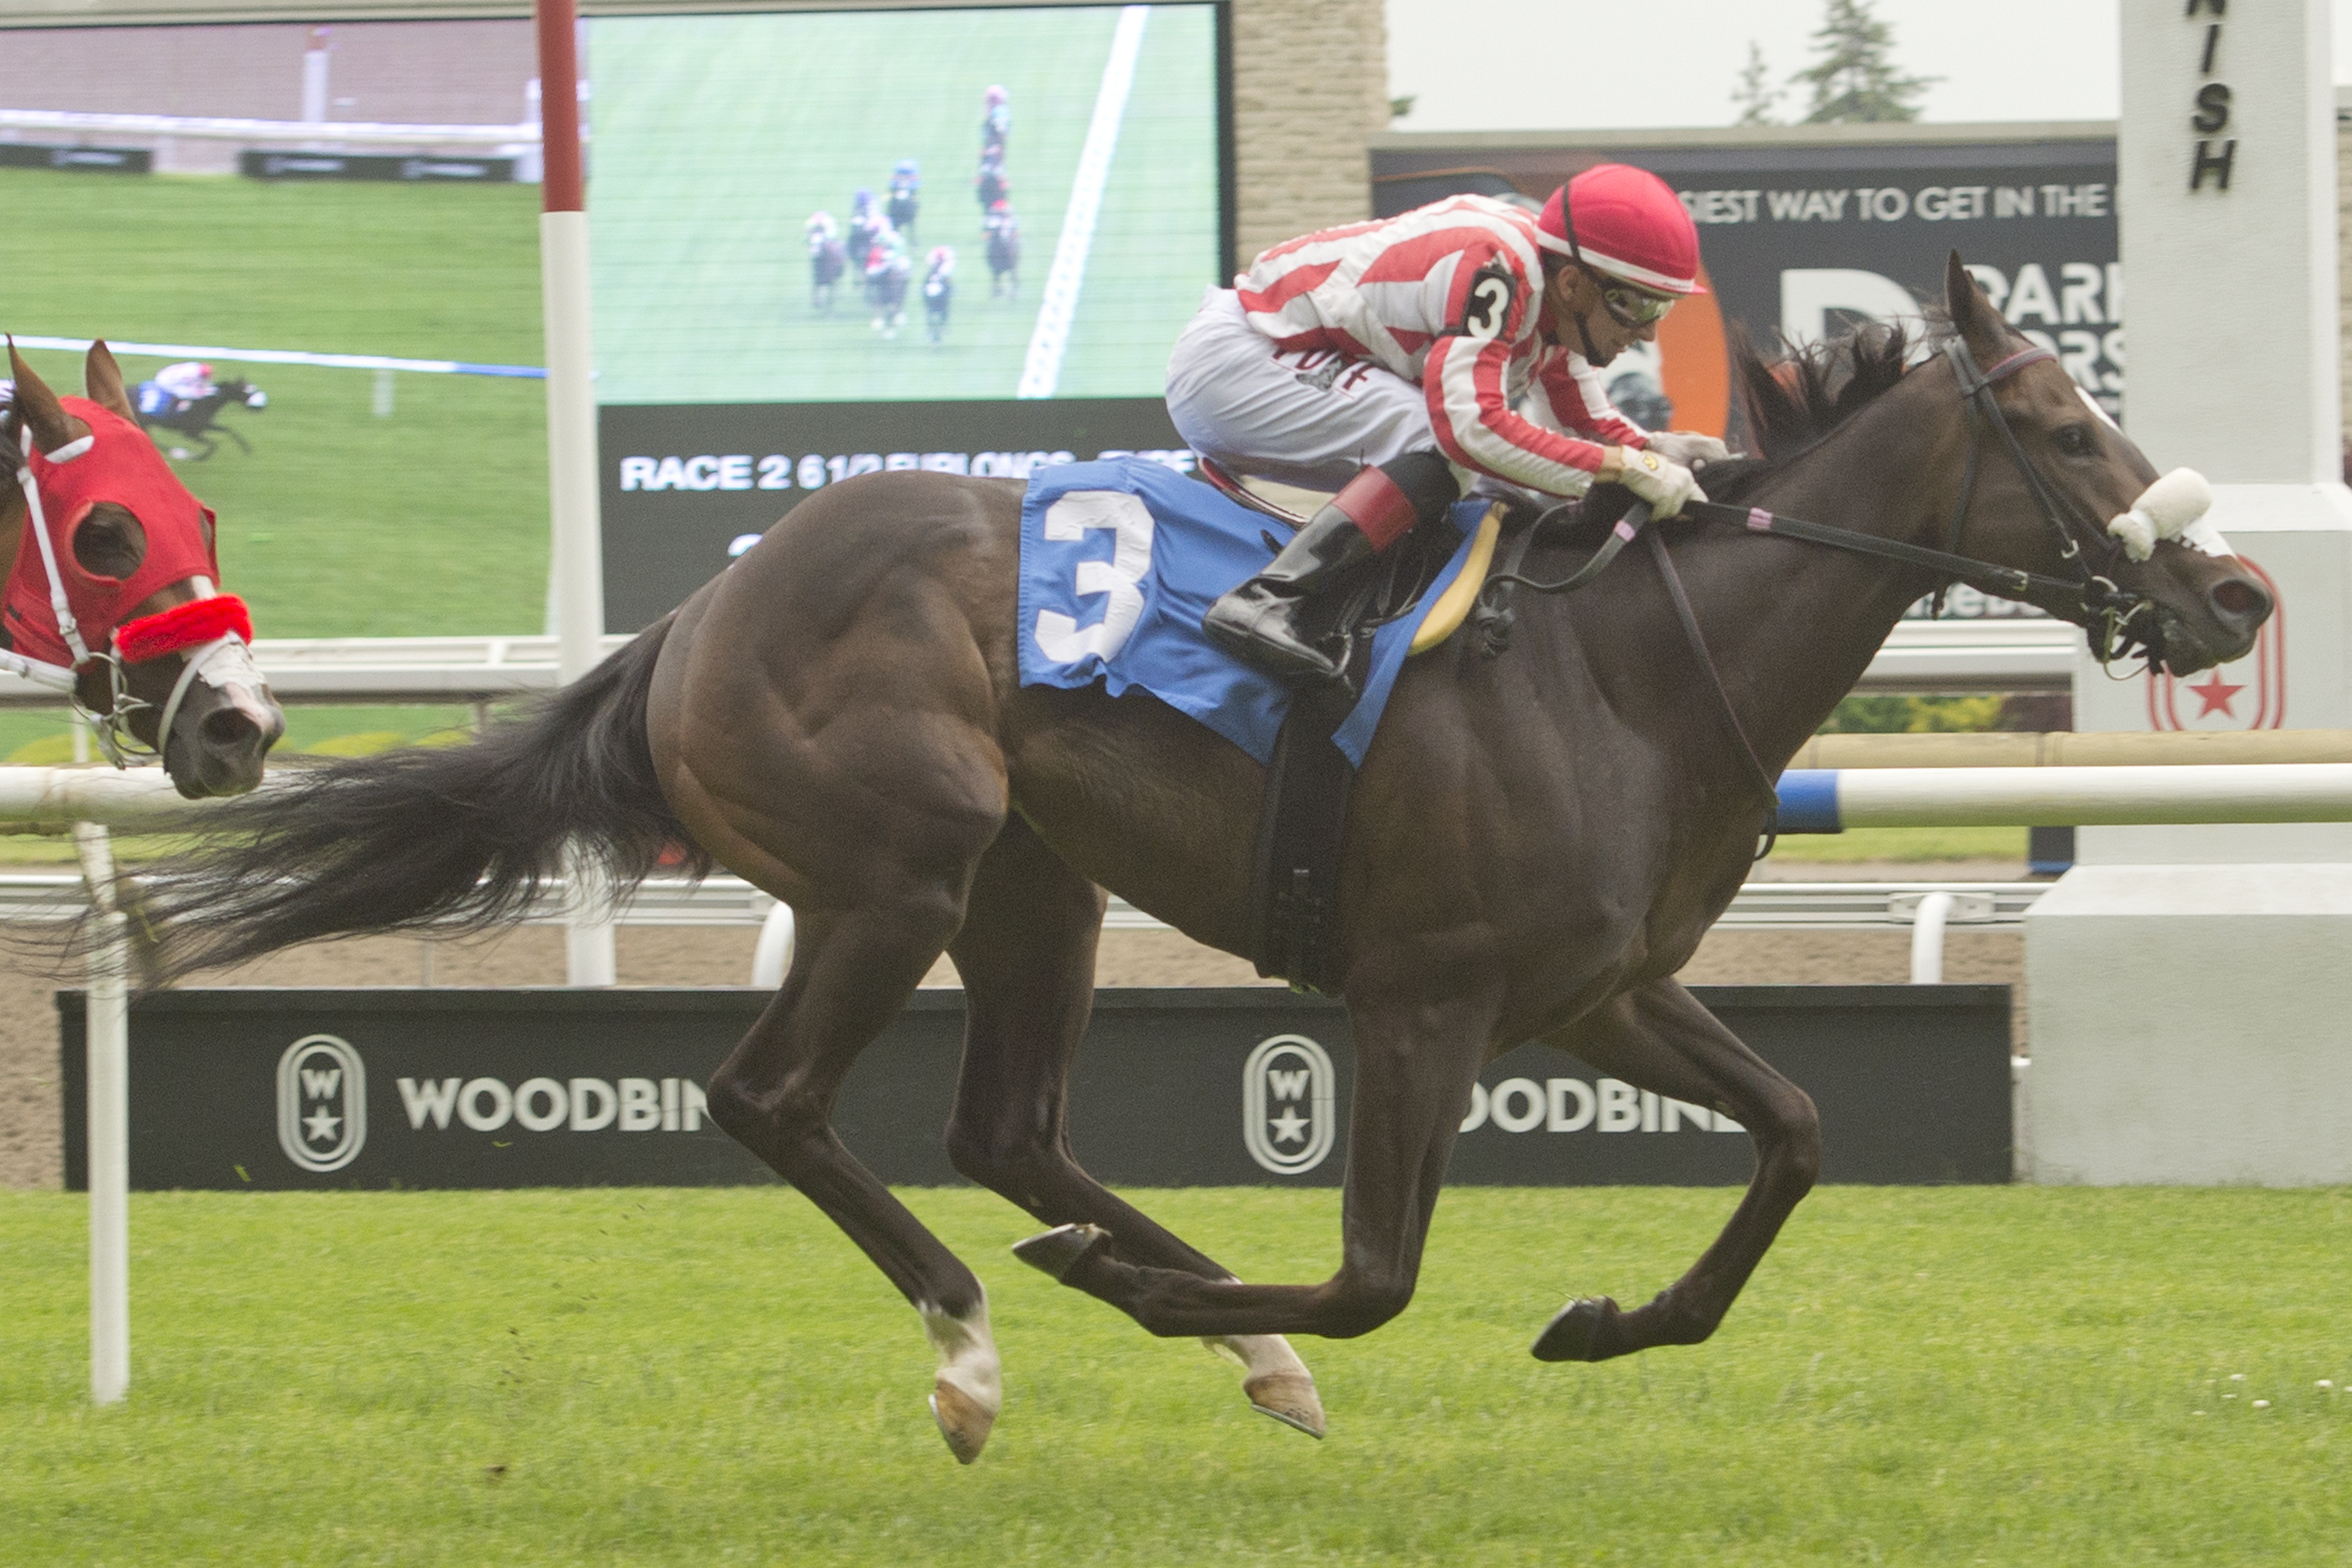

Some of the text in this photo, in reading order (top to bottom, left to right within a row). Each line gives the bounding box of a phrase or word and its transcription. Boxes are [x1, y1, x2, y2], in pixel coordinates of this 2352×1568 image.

[1767, 189, 1850, 221] WAY
[1854, 187, 1908, 221] TO
[1914, 186, 1988, 221] GET
[1994, 185, 2034, 218] IN
[2039, 184, 2108, 217] THE
[1467, 277, 1509, 338] 3
[620, 455, 754, 491] RACE
[757, 454, 792, 489] 2
[1034, 491, 1155, 662] 3
[301, 1068, 342, 1100] W
[1266, 1070, 1310, 1101] W
